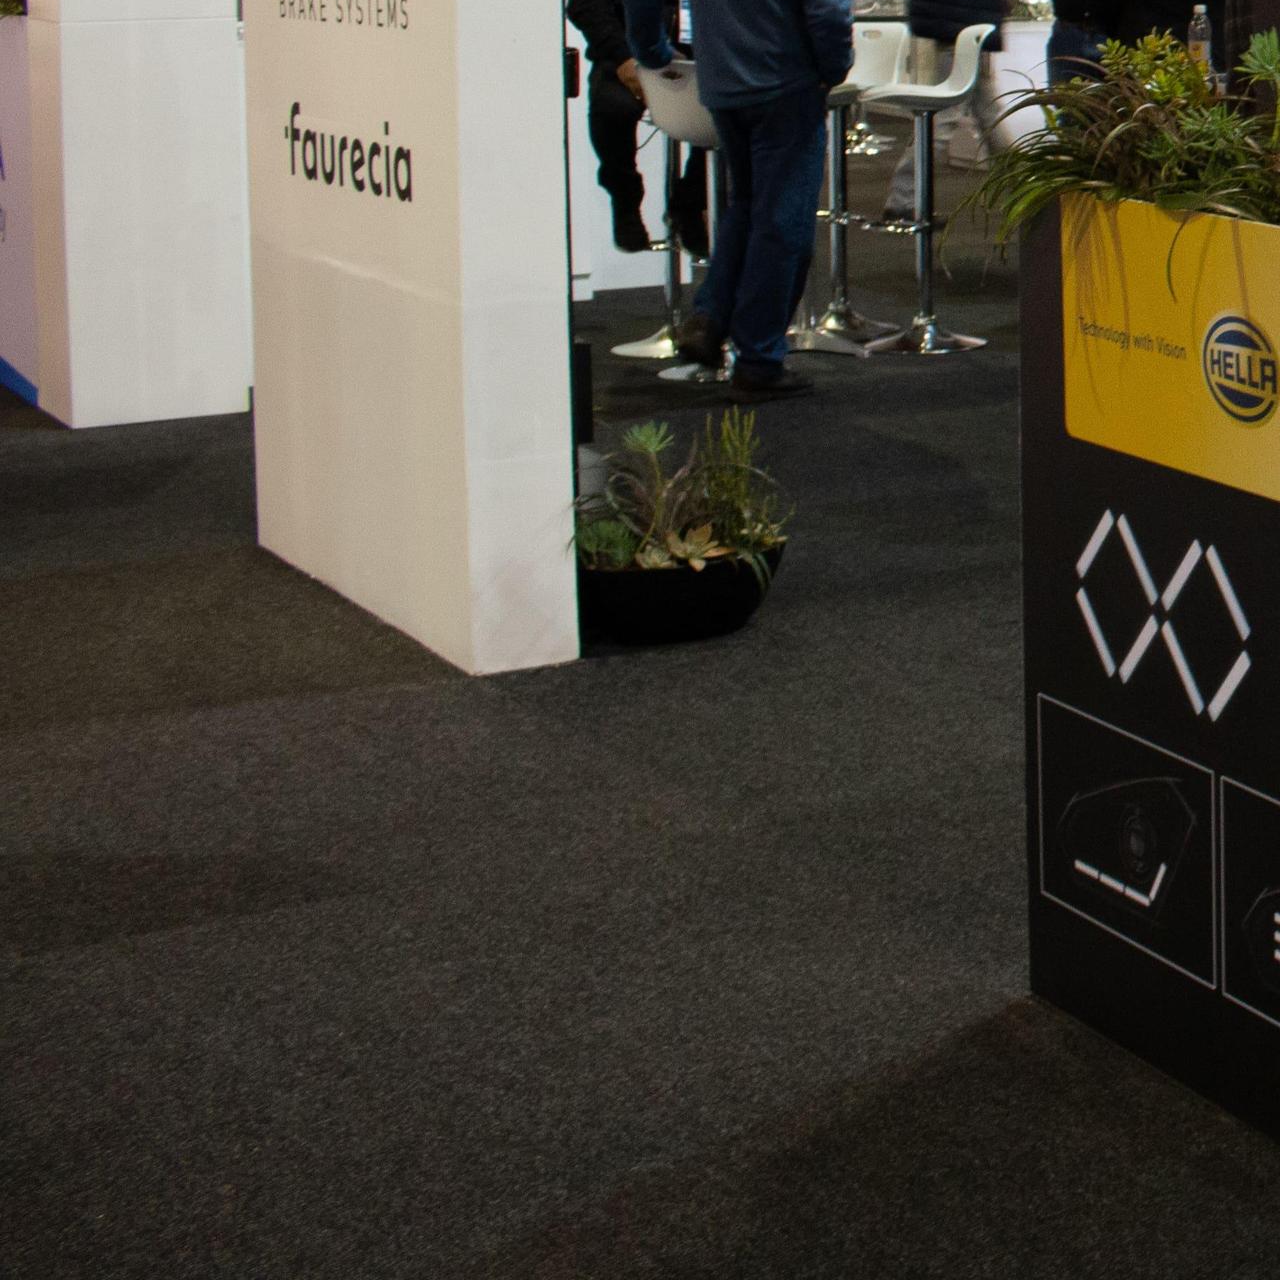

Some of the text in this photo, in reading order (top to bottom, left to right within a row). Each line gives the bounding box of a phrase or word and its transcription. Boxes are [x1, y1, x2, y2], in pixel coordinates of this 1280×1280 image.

[285, 101, 412, 203] faurecia
[1132, 334, 1154, 352] with
[1156, 336, 1187, 360] Vision
[1210, 348, 1277, 395] HELLA
